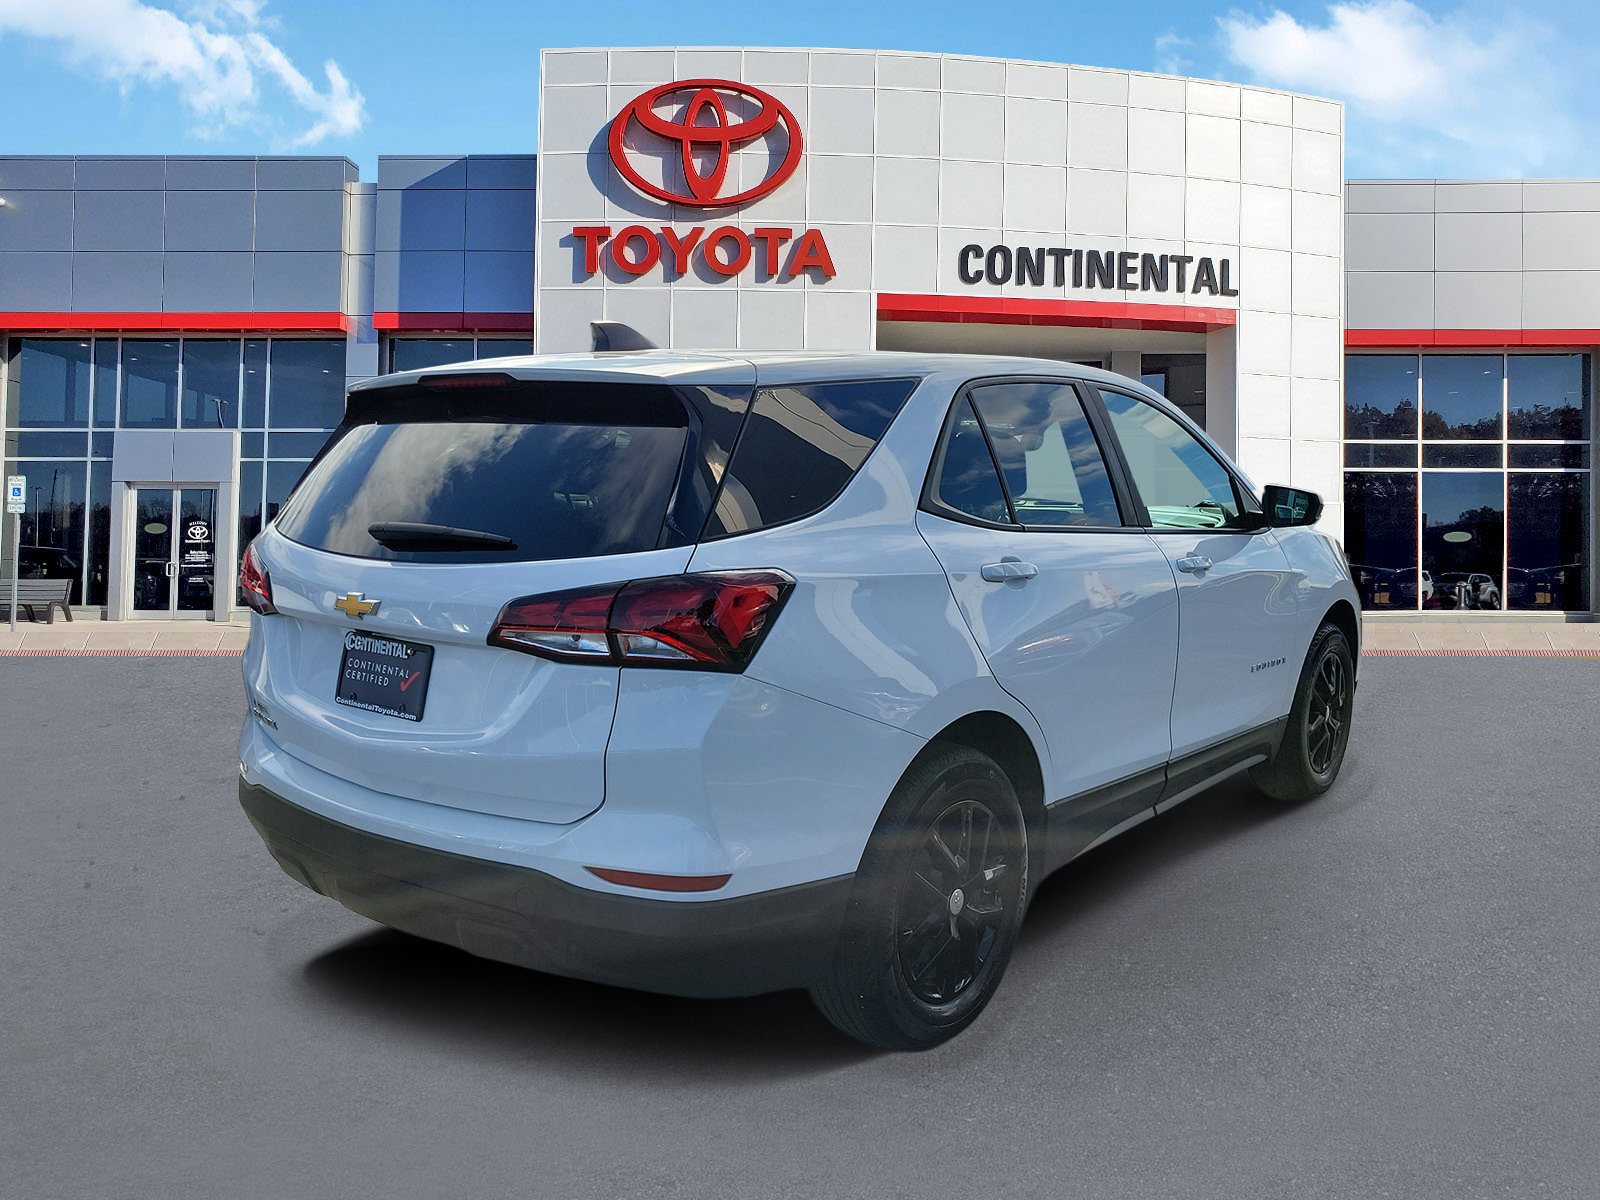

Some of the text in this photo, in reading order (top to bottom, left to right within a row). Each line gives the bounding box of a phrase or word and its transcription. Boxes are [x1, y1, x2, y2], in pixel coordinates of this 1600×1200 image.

[573, 225, 836, 276] TOYOTA
[958, 244, 1239, 297] CONTINENTAL
[345, 632, 408, 659] CONTINENTAL
[345, 669, 389, 687] CERTIFIED
[347, 658, 409, 679] CONTINENTAL
[335, 696, 417, 721] ContinentalToyota.com
